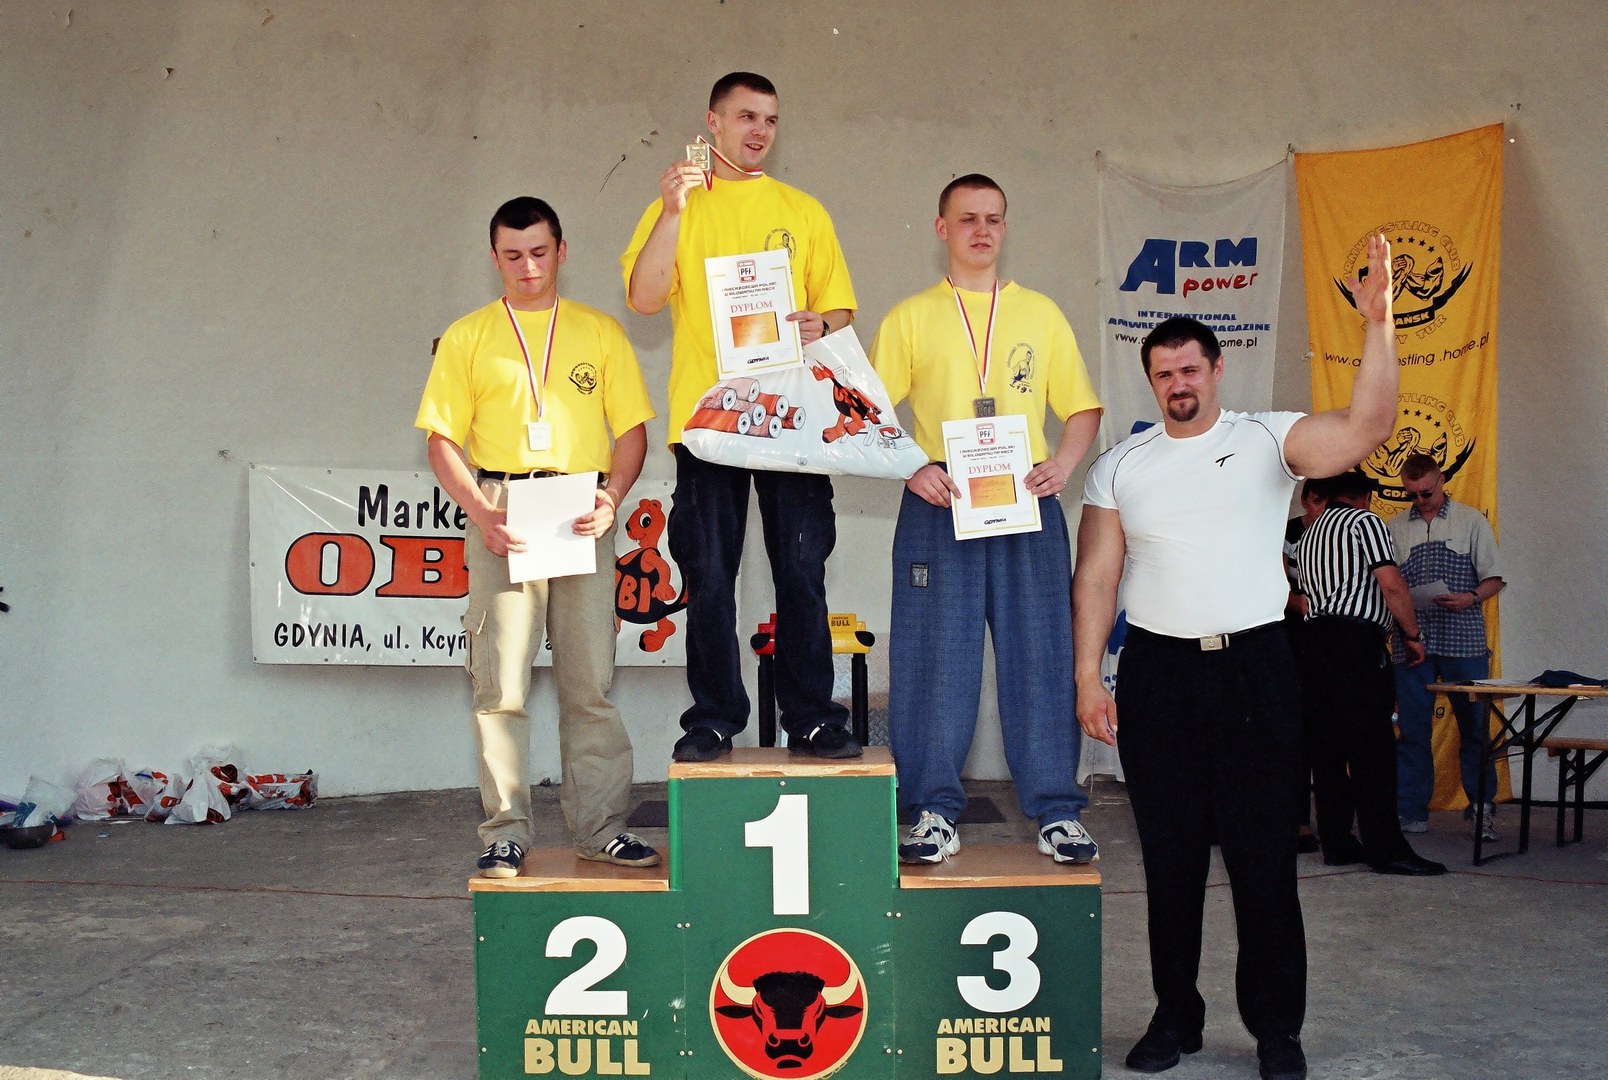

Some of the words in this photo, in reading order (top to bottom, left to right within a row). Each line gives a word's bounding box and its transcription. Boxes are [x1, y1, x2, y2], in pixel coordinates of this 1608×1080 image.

[1119, 237, 1258, 294] ARM
[1440, 235, 1461, 272] CLUB
[1182, 272, 1259, 298] power
[730, 300, 773, 314] DYPLOM
[1137, 310, 1237, 321] INTERNATIONAL
[1395, 310, 1430, 326] AŃSK
[1207, 323, 1271, 332] MAGAZINE
[1415, 314, 1447, 340] TUR
[1445, 410, 1465, 447] CLUB
[968, 463, 1012, 475] DYPLOM
[357, 483, 468, 531] Marke
[285, 531, 469, 598] OB
[617, 574, 651, 613] BI
[274, 622, 371, 652] GDYNIA,
[384, 625, 410, 649] ul.
[422, 626, 467, 657] Kcyń
[744, 794, 810, 915] 1
[544, 915, 628, 1016] 2
[956, 911, 1041, 1013] 3
[524, 1018, 638, 1036] AMERICAN
[936, 1017, 1051, 1034] AMERICAN
[524, 1038, 651, 1076] BULL
[936, 1036, 1063, 1074] BULL
